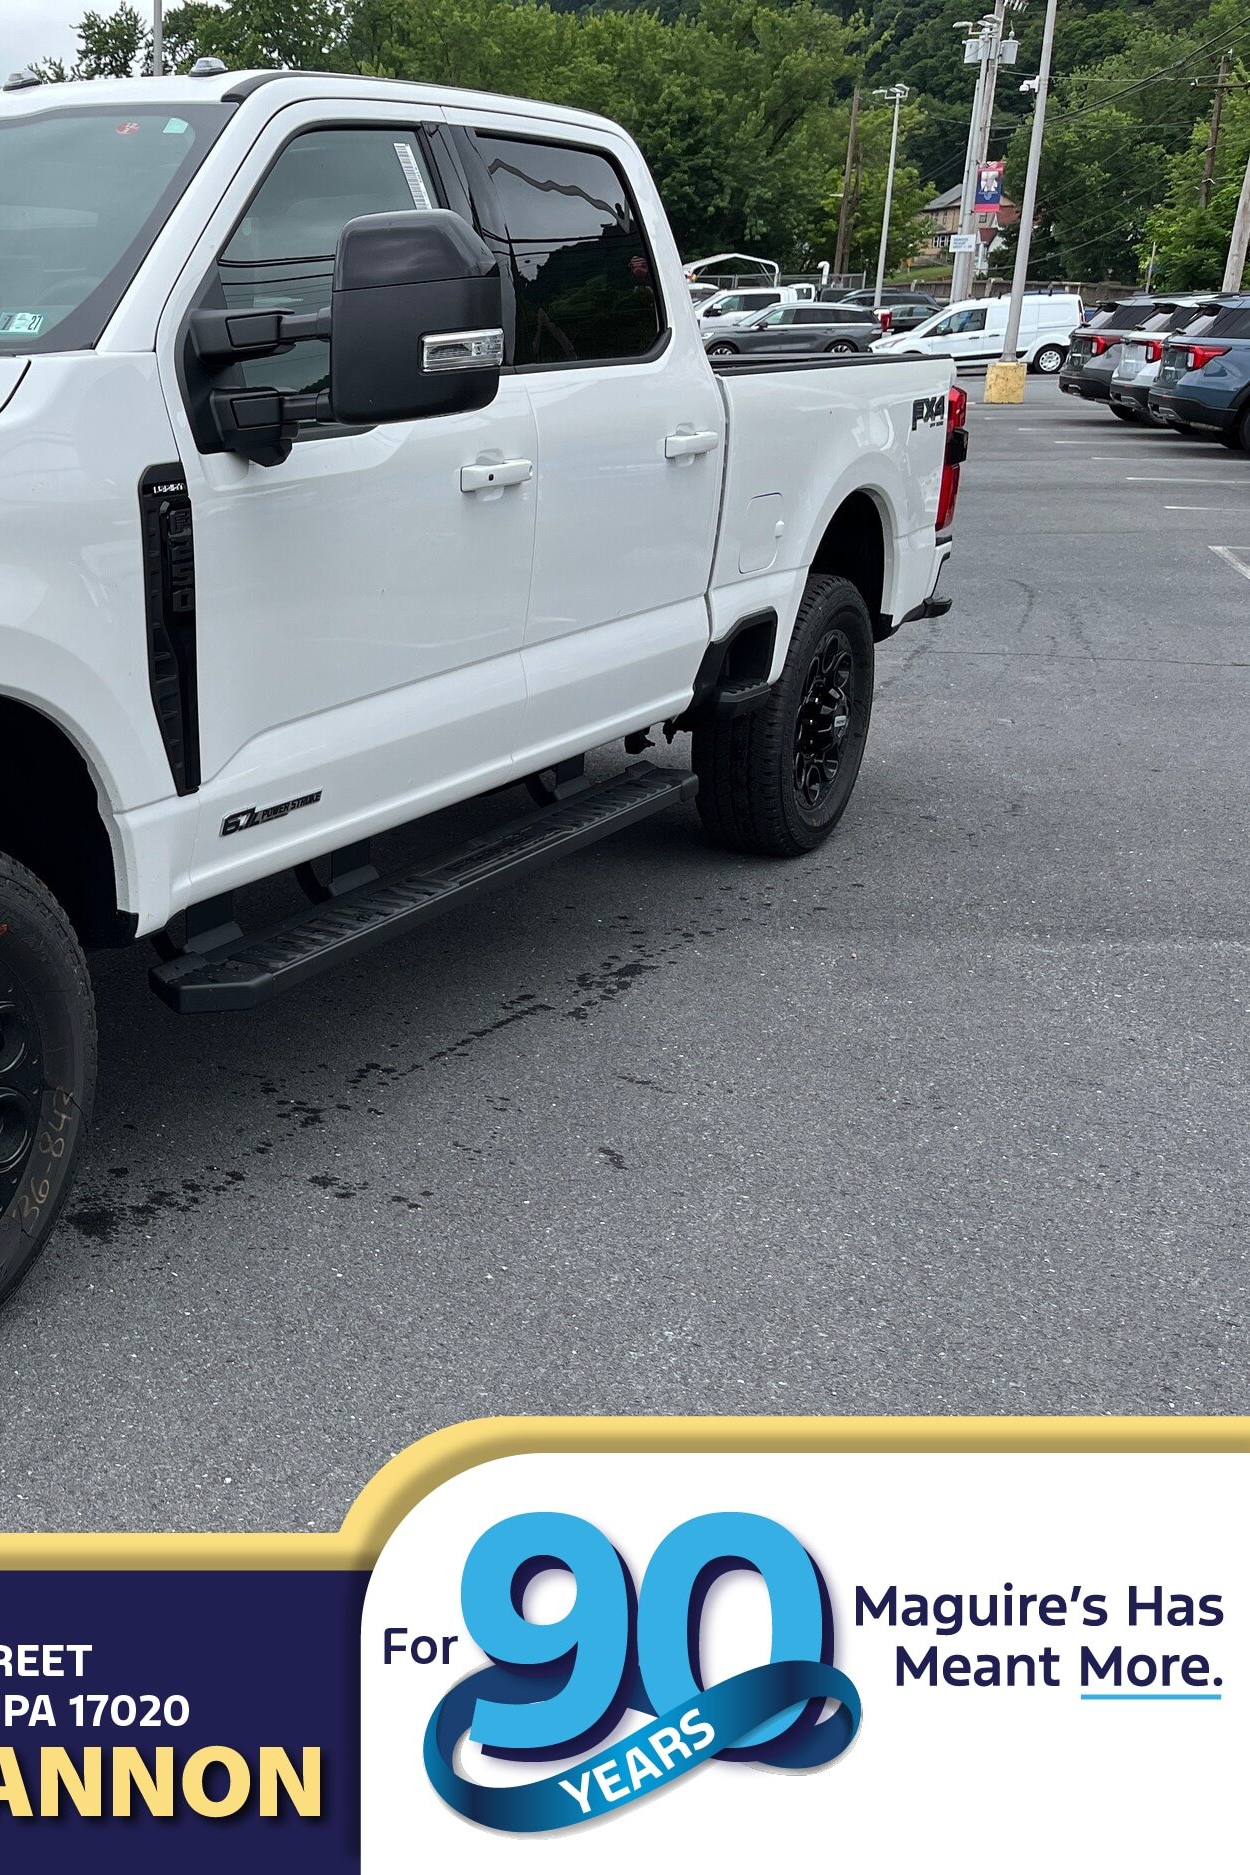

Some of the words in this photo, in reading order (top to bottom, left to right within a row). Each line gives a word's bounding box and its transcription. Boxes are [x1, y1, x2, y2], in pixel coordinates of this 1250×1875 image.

[28, 315, 42, 331] 27
[911, 395, 945, 431] FX4
[261, 801, 290, 820] POWER
[290, 791, 322, 811] STROKE
